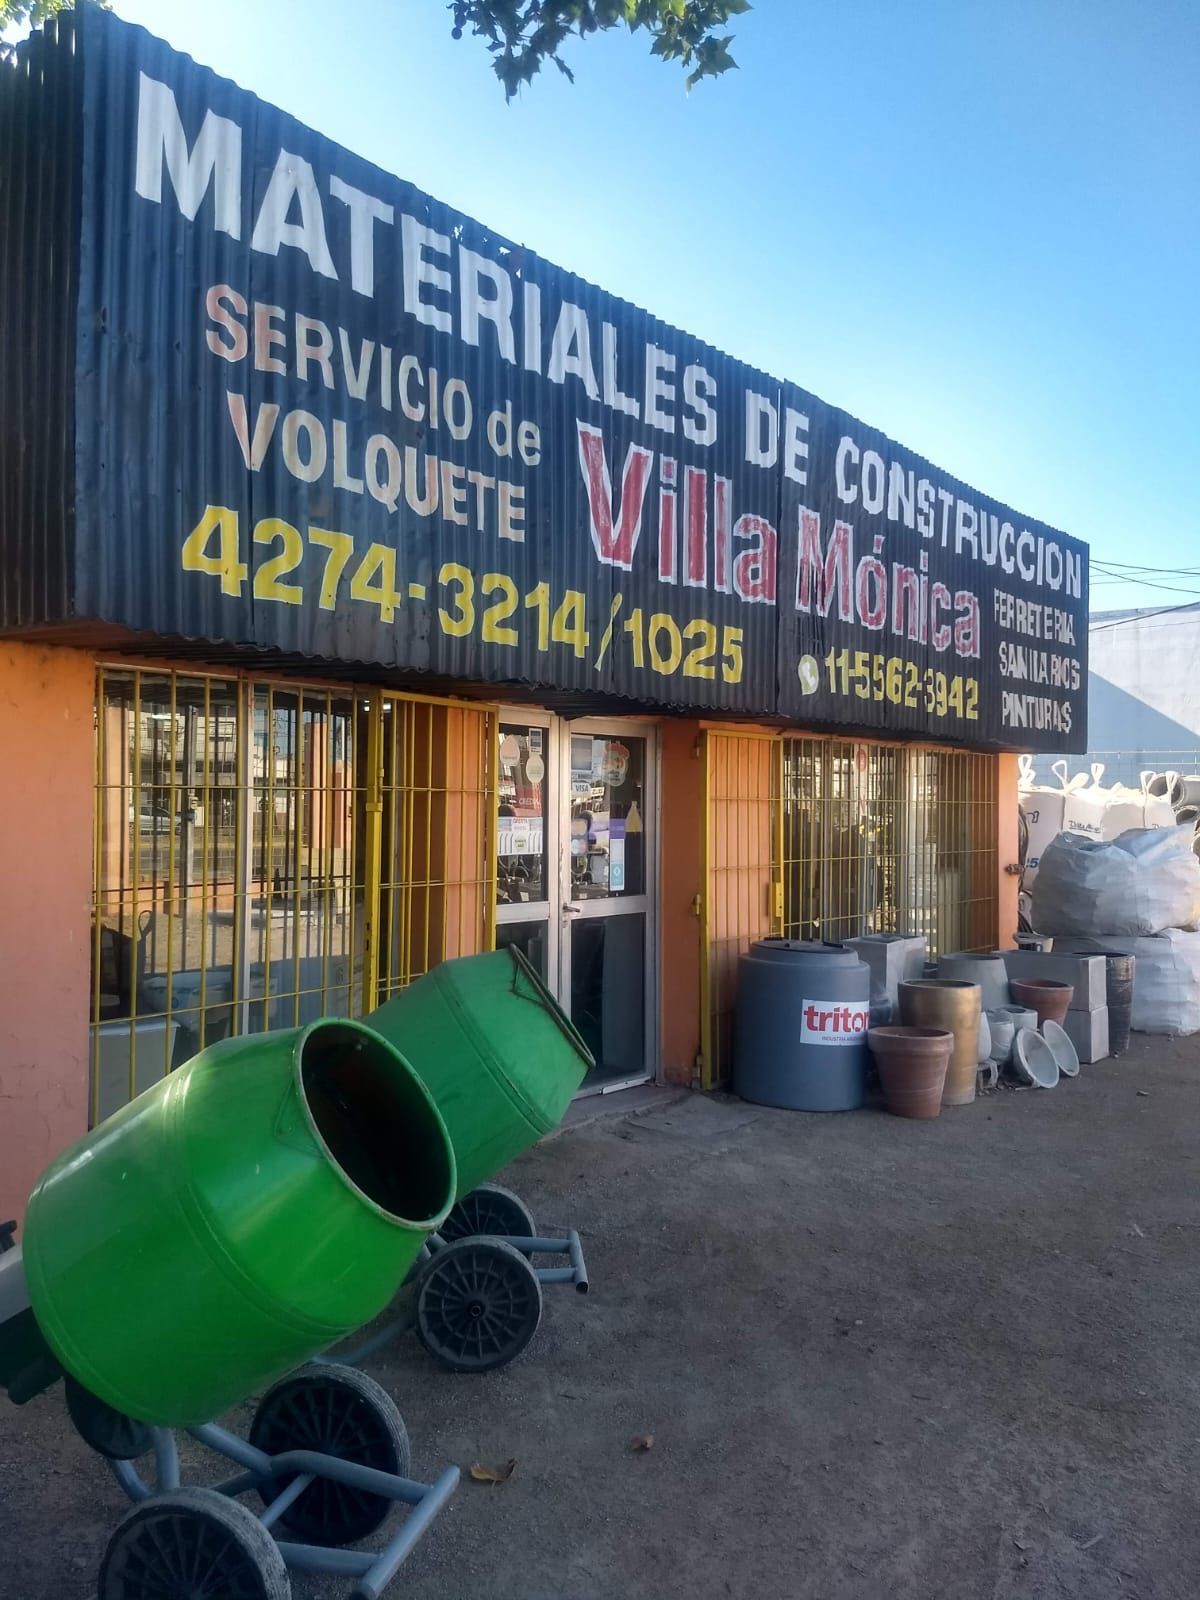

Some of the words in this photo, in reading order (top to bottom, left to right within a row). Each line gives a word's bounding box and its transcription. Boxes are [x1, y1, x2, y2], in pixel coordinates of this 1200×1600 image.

[135, 71, 717, 447] MATERIALES
[745, 389, 810, 486] DE
[835, 436, 1081, 598] CONSTRUCCION
[206, 284, 473, 440] SERVICIO
[487, 400, 541, 466] de
[226, 389, 526, 543] VOLQUETE
[576, 418, 777, 606] Villa
[795, 504, 981, 659] Mónica
[994, 588, 1076, 646] FERRETERIA
[825, 646, 979, 720] 11-5562-3942
[1002, 691, 1072, 734] PINTURAS
[575, 784, 589, 792] VISA
